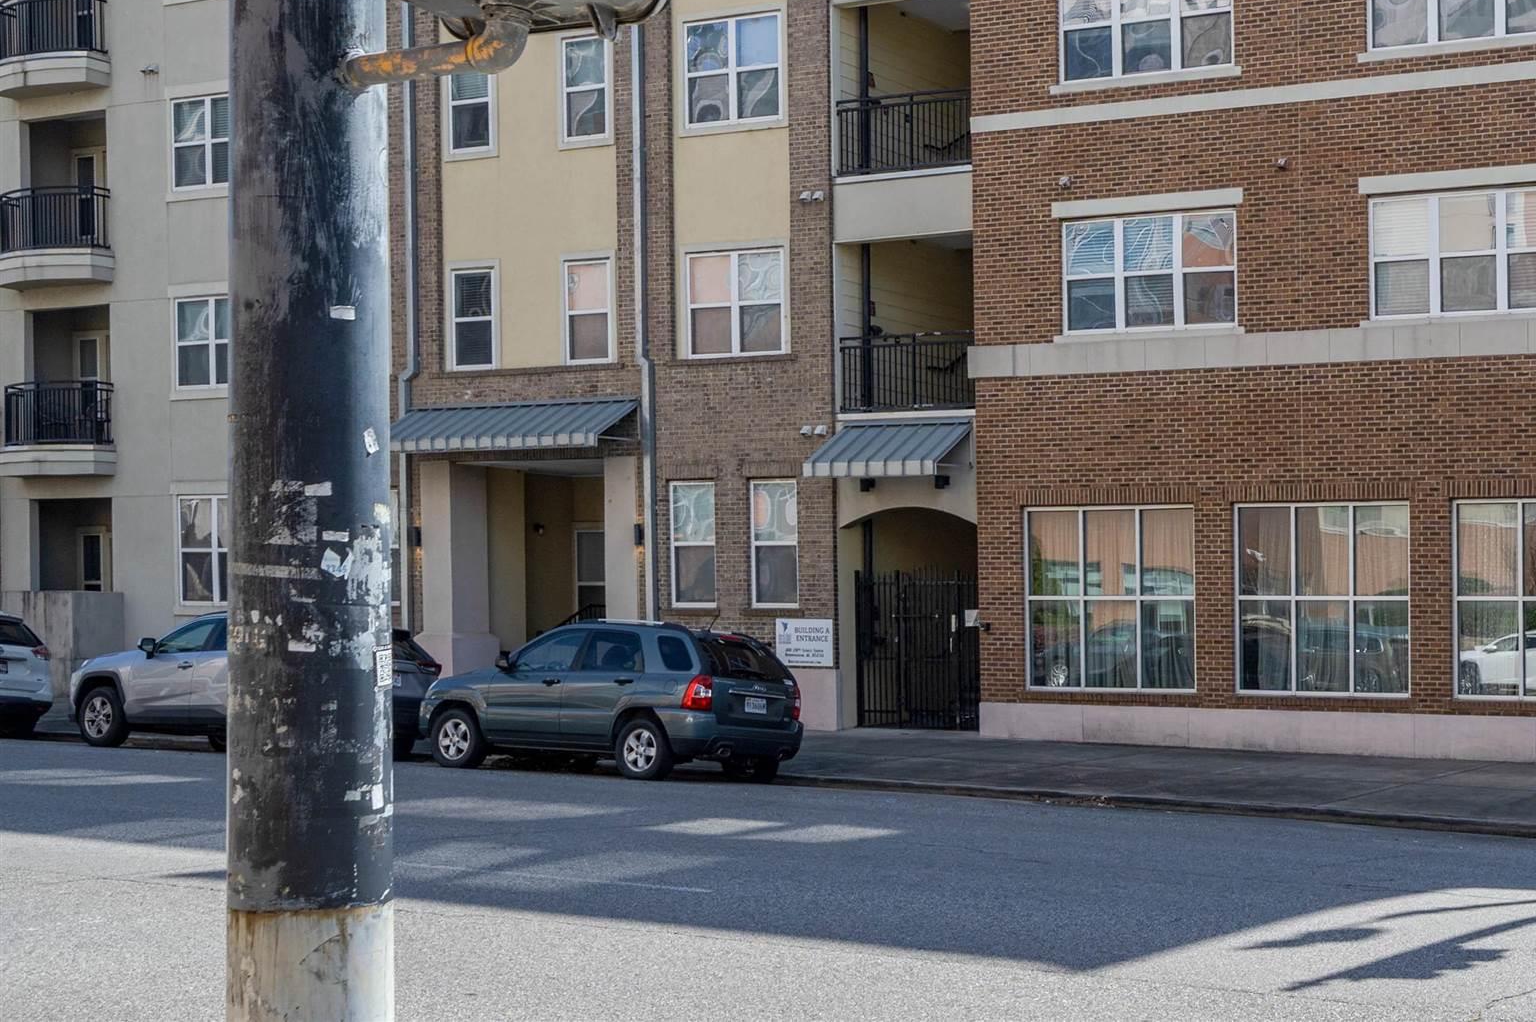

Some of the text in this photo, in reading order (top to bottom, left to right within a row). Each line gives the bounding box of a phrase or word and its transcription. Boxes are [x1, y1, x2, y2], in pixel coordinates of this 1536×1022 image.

[794, 626, 830, 635] BUILDING A
[796, 634, 829, 643] ENTRANCE
